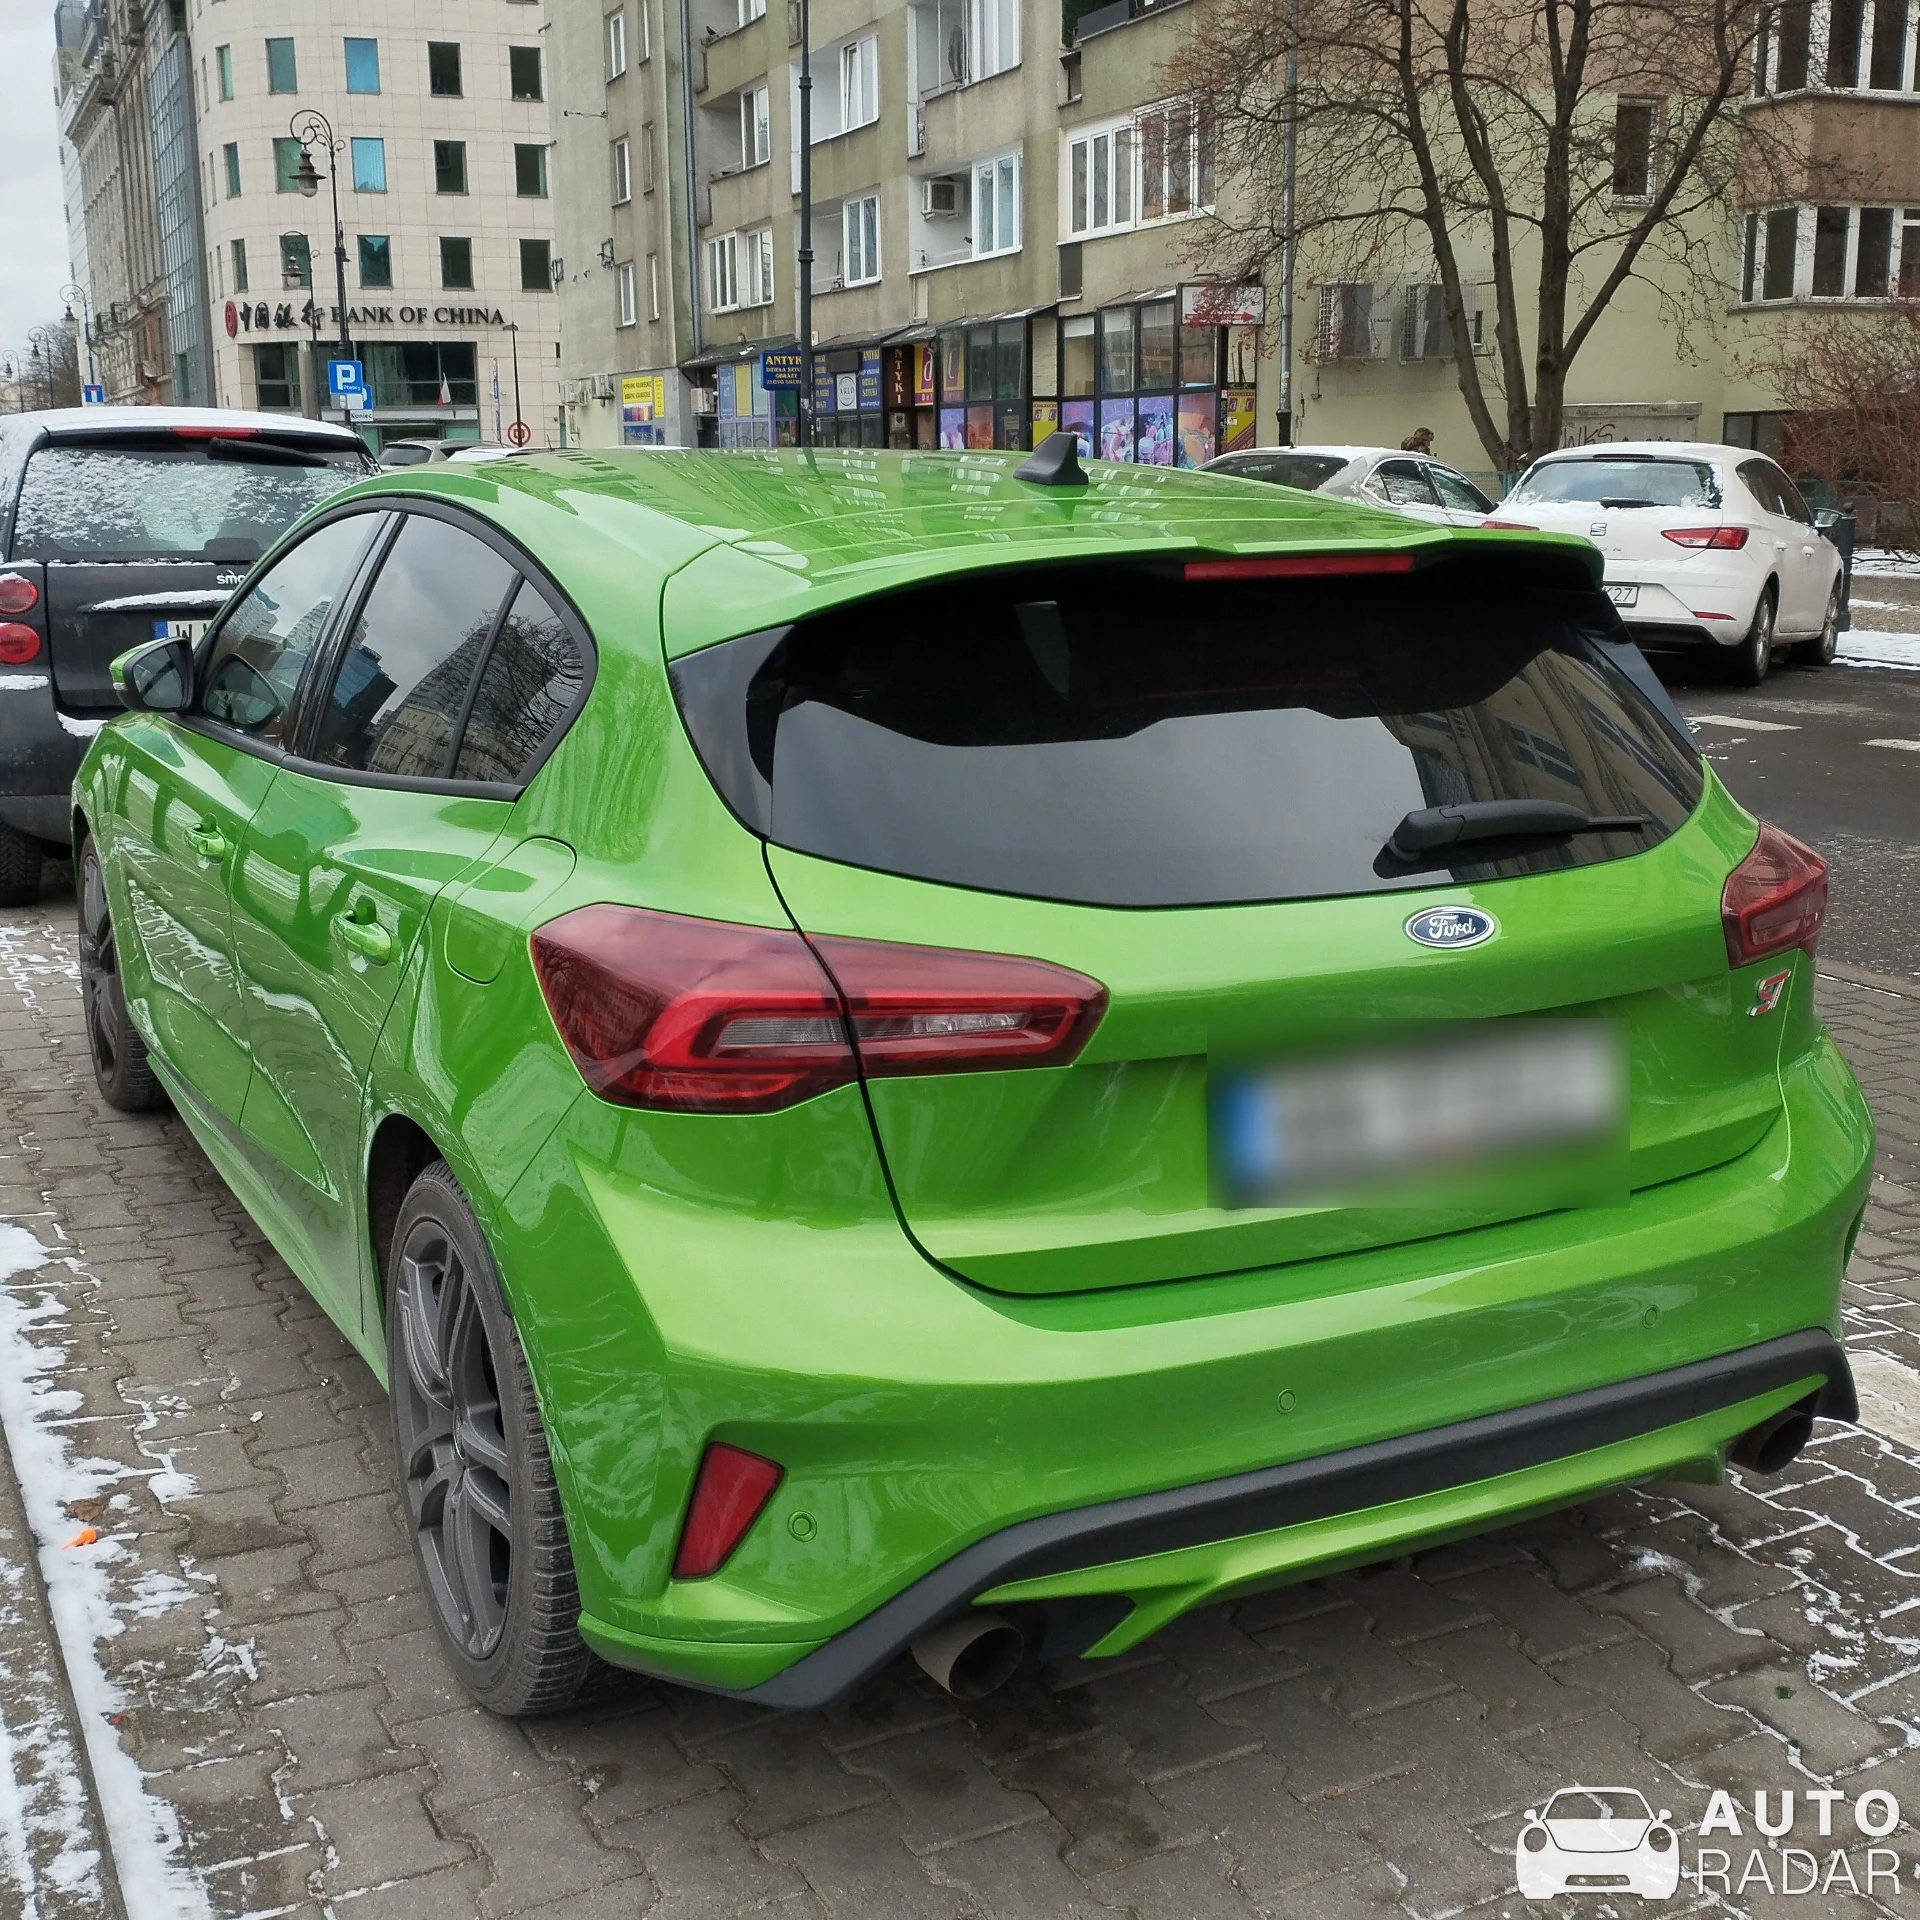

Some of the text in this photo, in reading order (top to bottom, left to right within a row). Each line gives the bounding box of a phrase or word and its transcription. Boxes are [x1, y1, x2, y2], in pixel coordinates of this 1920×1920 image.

[330, 306, 505, 325] BANK OF CHINA
[766, 355, 802, 365] ANTYK
[336, 364, 356, 391] P
[894, 348, 904, 404] NTYKI
[1429, 914, 1476, 939] Ford
[1745, 969, 1792, 1017] ST
